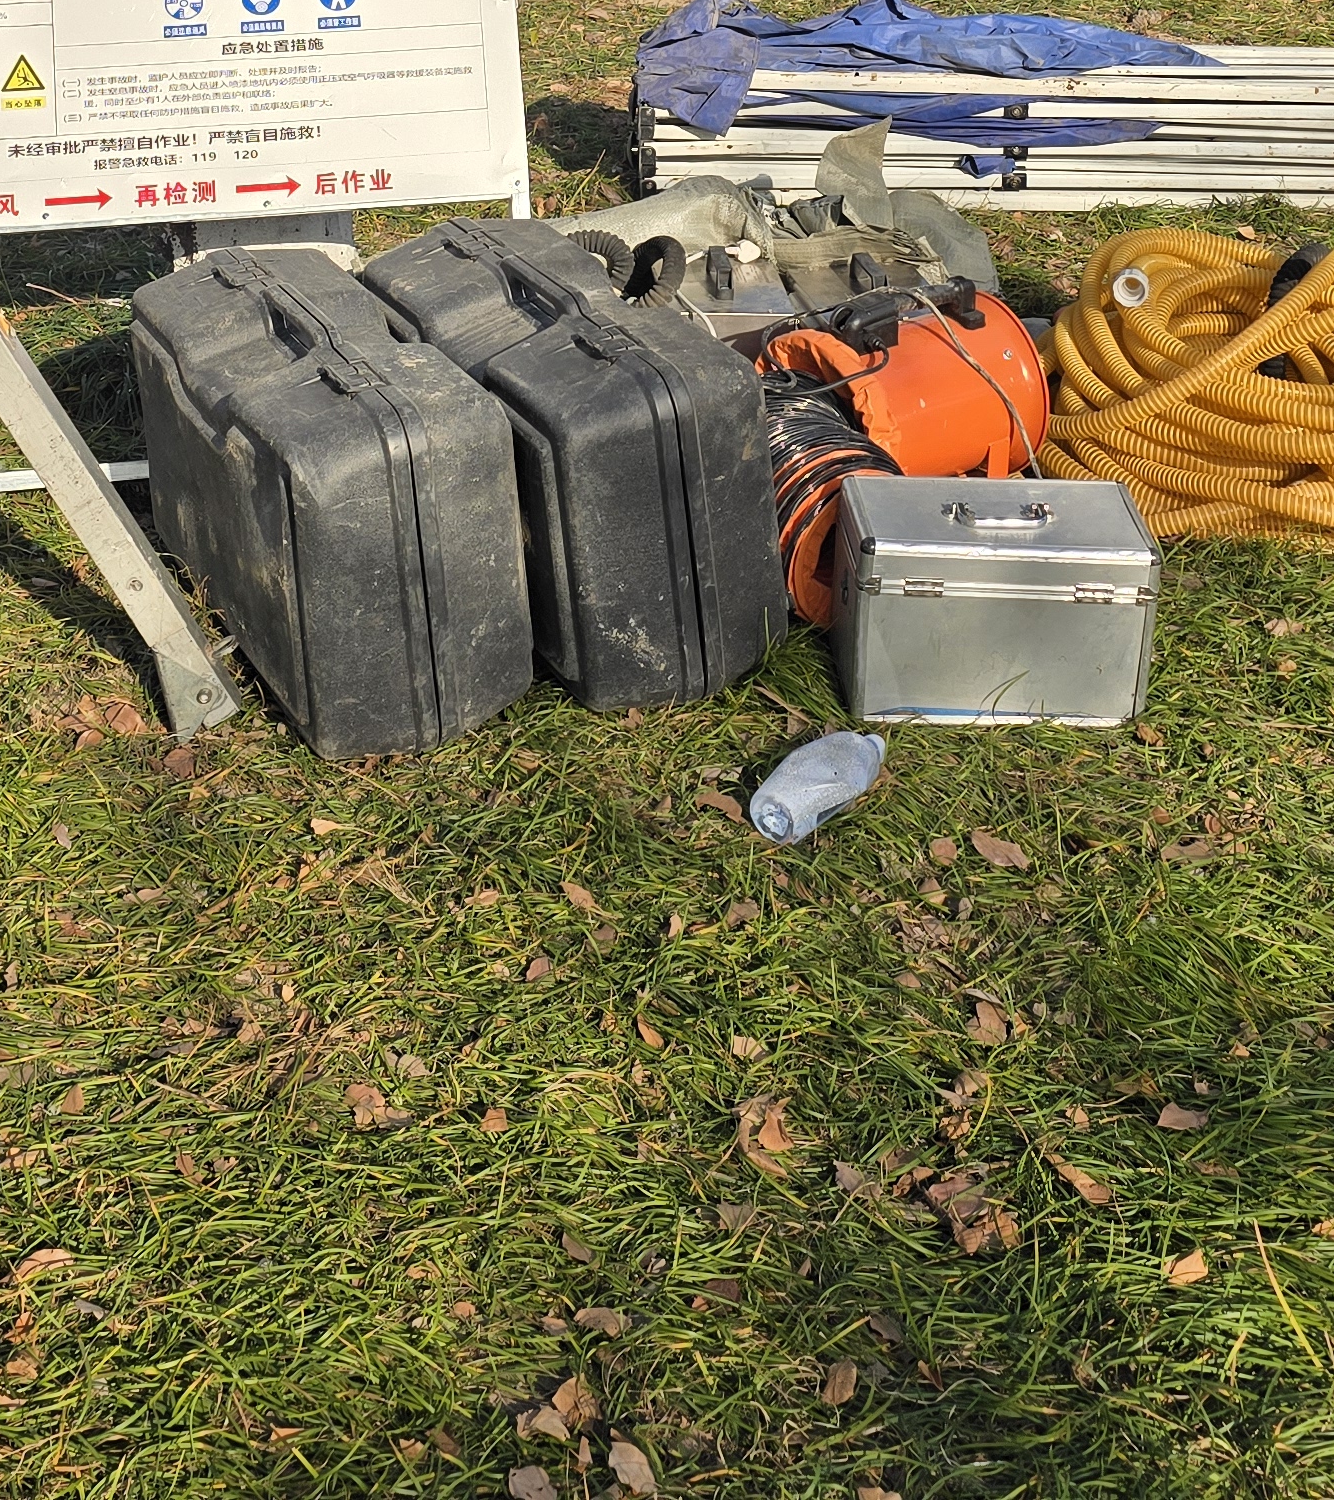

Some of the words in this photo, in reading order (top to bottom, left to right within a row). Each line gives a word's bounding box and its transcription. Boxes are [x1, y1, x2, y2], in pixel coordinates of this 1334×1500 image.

[222, 37, 325, 56] 应急处置措施
[5, 99, 42, 109] 当心坠落
[234, 149, 258, 161] 120
[134, 180, 217, 207] 再检测
[314, 169, 394, 195] 后作业
